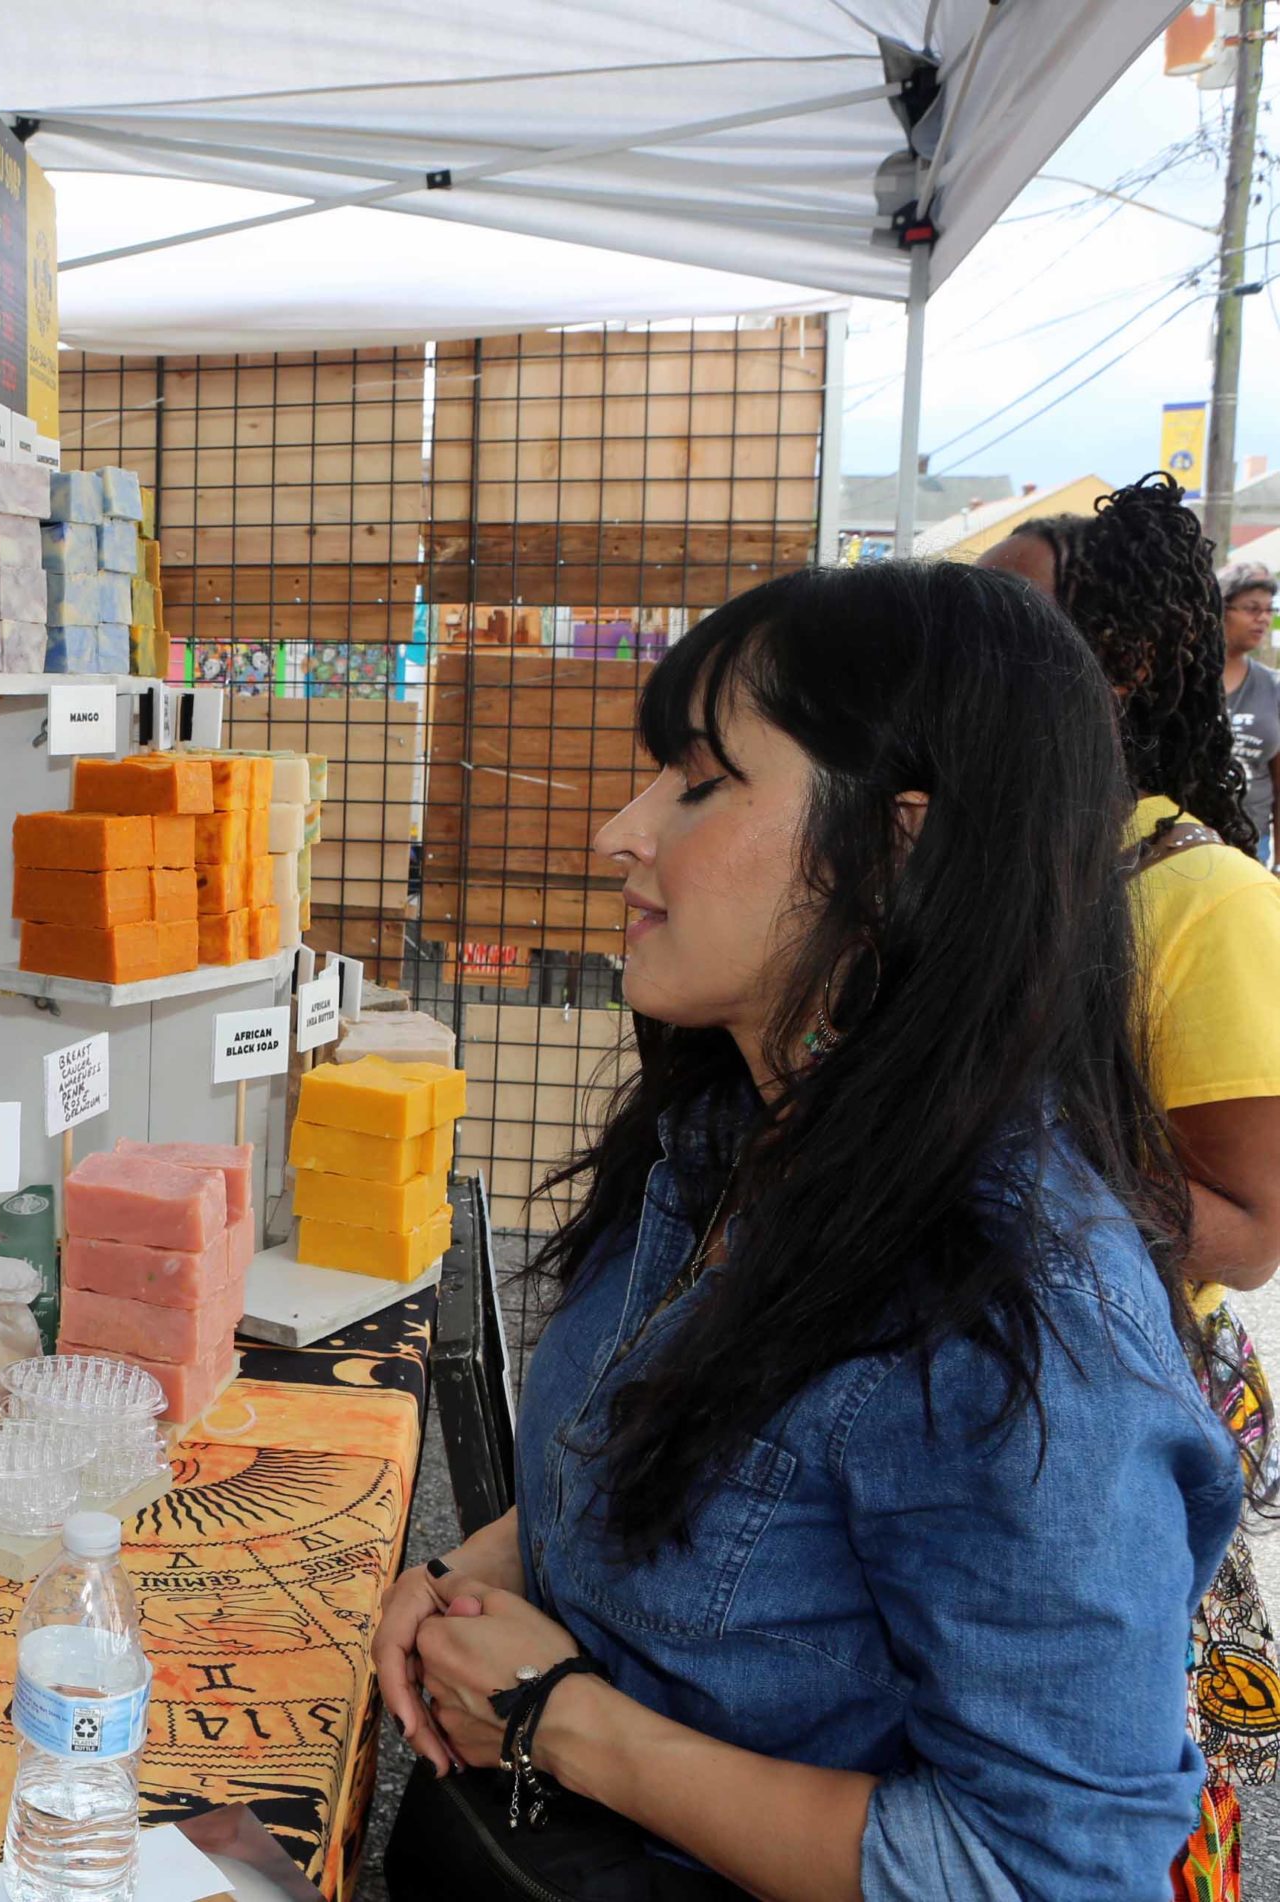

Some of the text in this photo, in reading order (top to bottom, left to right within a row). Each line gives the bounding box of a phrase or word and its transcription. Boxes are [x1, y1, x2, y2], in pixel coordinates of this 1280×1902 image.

[69, 712, 100, 723] MANGO
[311, 999, 331, 1013] AFRICAN
[234, 1027, 272, 1042] AFRICAN
[59, 1042, 93, 1070] BREAST
[226, 1040, 280, 1057] BLACK SOAP
[62, 1057, 92, 1080] CANCER
[62, 1081, 85, 1106] PINK
[64, 1089, 90, 1114] ROSE
[166, 1551, 204, 1569] V
[140, 1575, 241, 1588] GEMINI
[185, 1708, 272, 1741] 14
